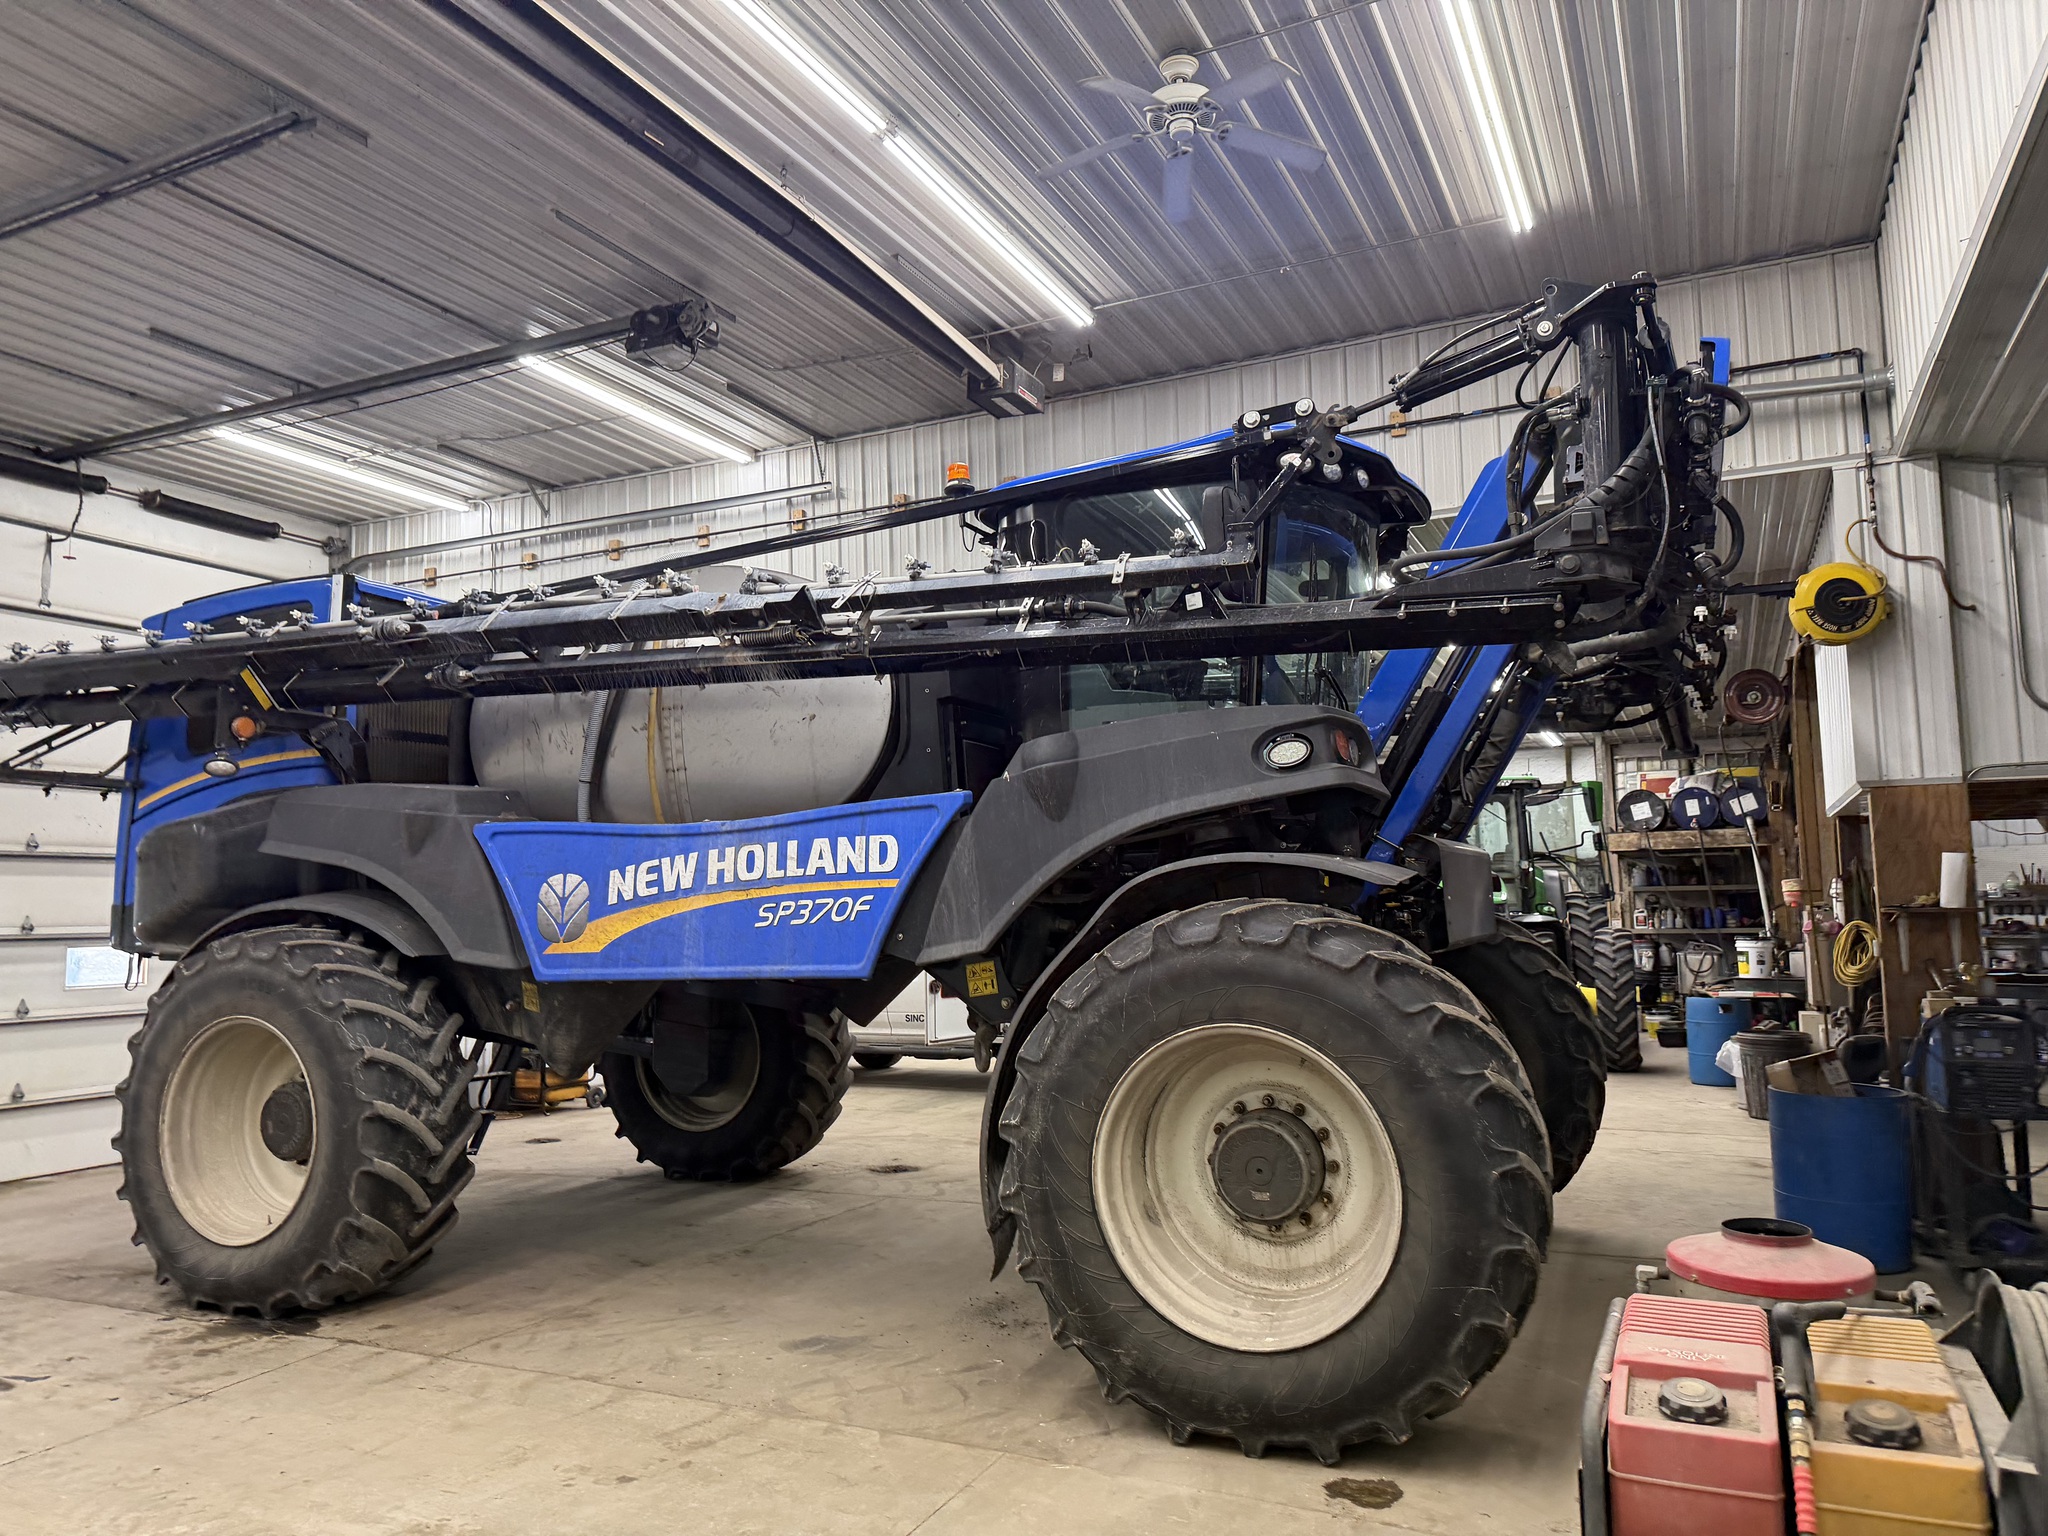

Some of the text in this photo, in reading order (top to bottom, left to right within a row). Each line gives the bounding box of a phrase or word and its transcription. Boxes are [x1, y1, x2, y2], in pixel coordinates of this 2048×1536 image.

[607, 834, 900, 906] NEW HOLLAND
[754, 894, 875, 929] SP370F
[904, 1013, 925, 1023] SINC
